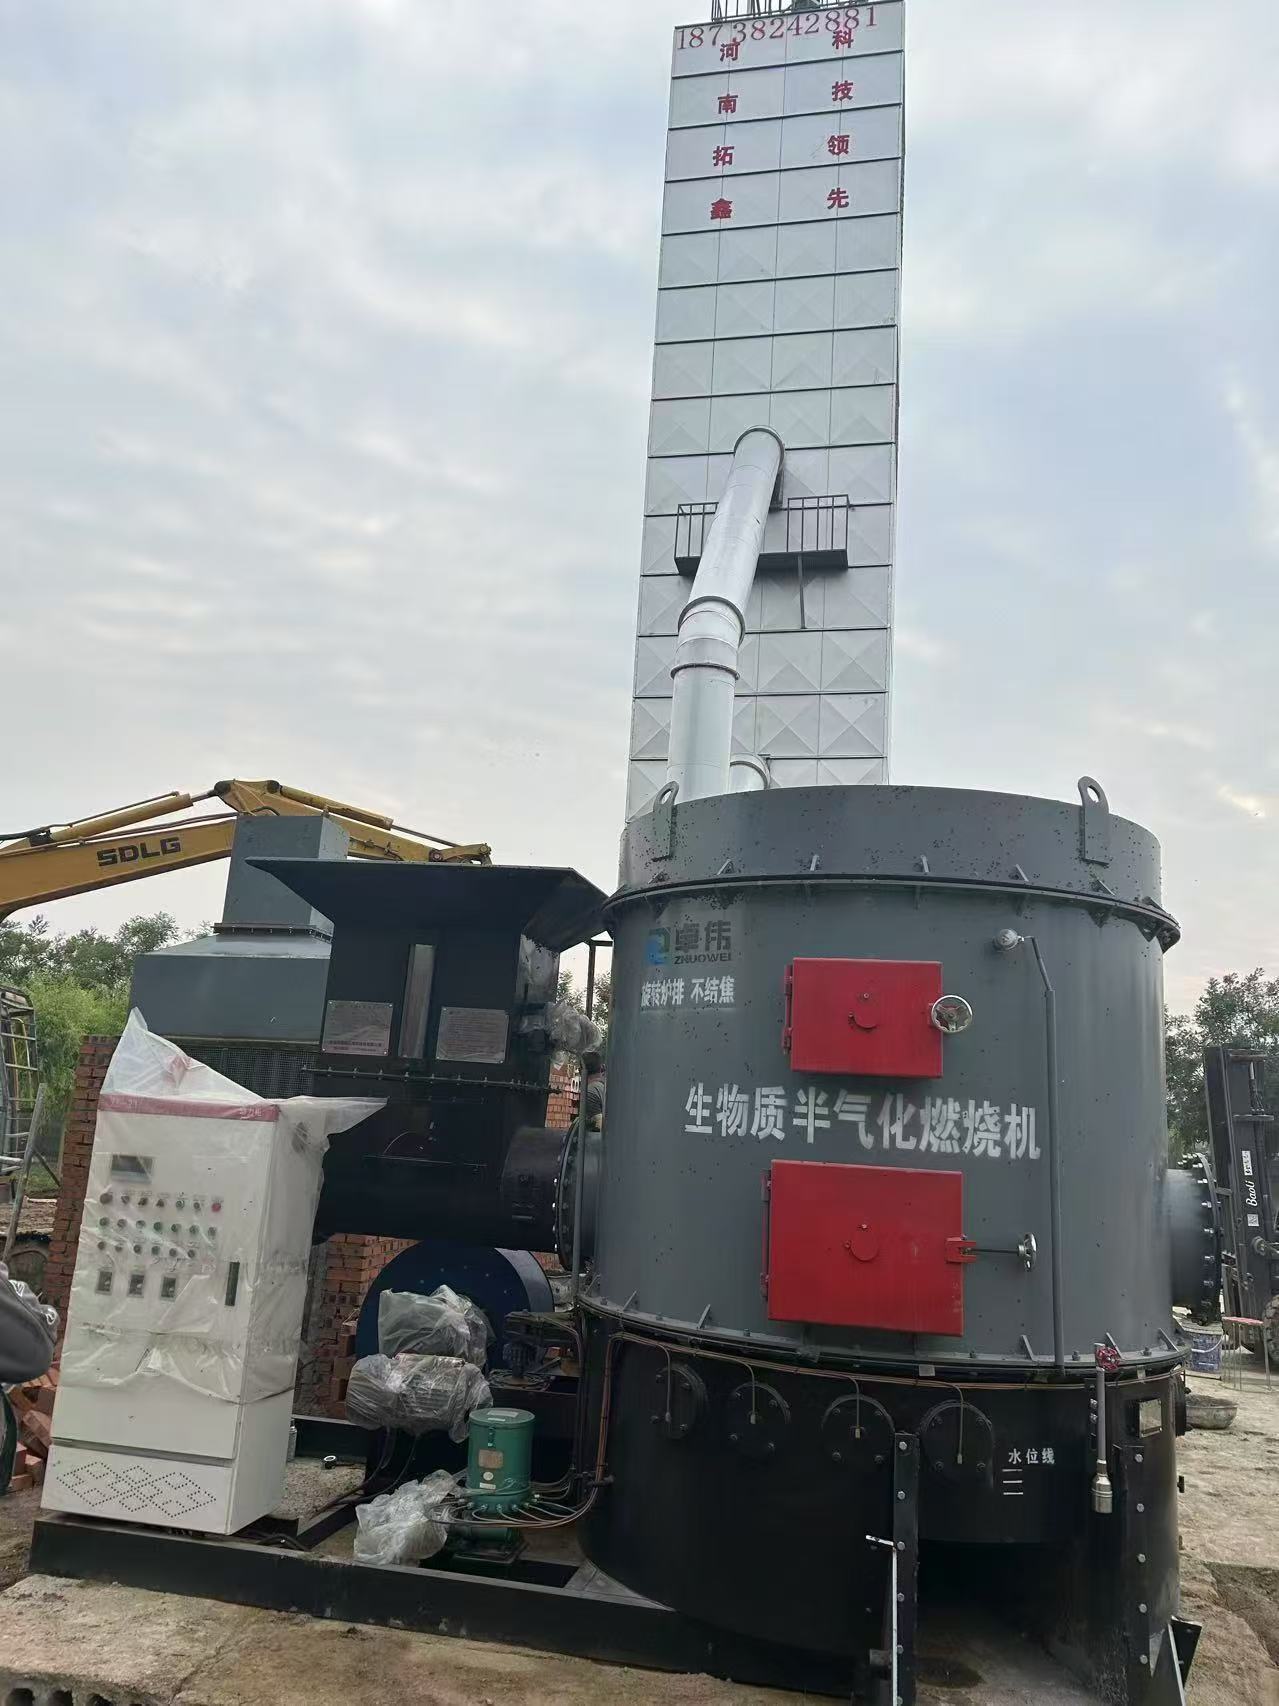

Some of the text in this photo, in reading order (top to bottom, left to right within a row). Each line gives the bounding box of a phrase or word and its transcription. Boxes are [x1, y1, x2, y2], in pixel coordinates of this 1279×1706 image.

[676, 5, 878, 50] 18738242881
[710, 37, 741, 221] 河南拓鑫
[826, 28, 854, 210] 科技领先
[97, 836, 181, 866] SDLG
[690, 975, 735, 1004] 不结焦
[684, 1081, 1041, 1161] 生物质半气化燃烧机
[1245, 1180, 1258, 1207] Baoli
[1008, 1447, 1055, 1465] 水位线
